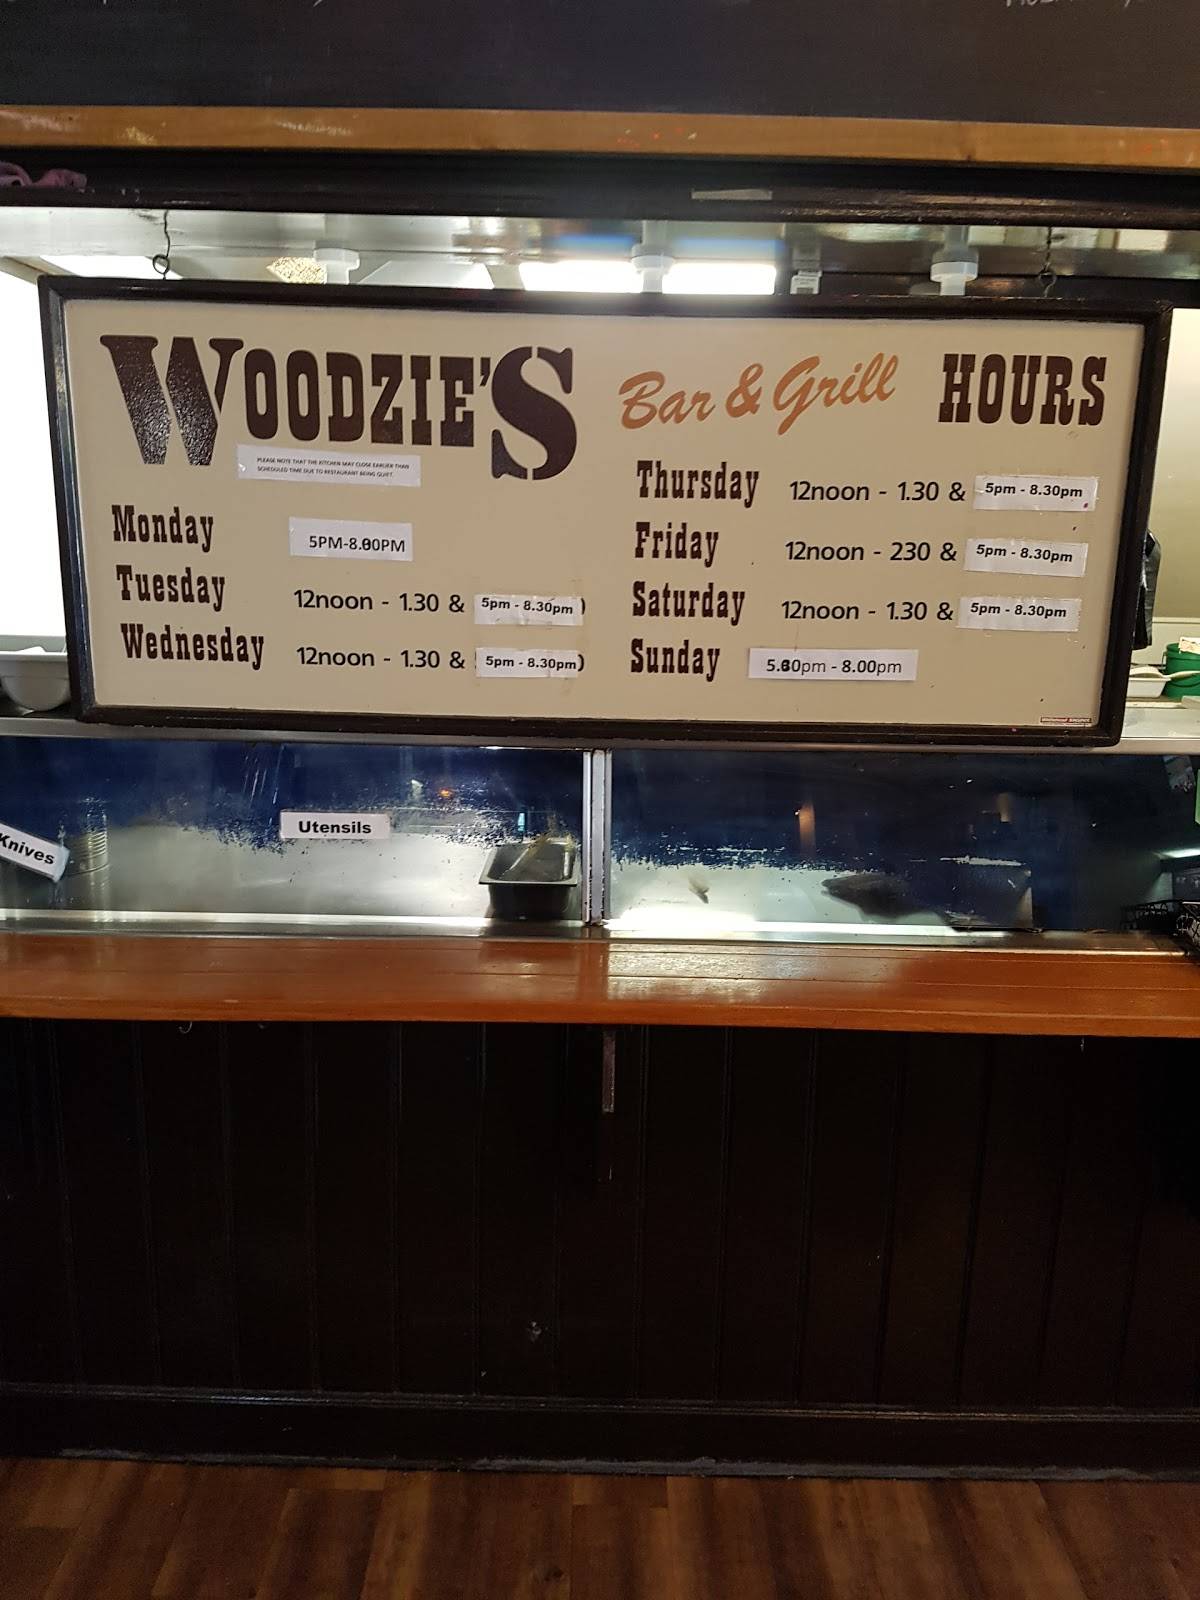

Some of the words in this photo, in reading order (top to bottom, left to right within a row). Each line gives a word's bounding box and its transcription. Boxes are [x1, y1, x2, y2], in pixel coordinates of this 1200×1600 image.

[619, 370, 715, 429] Bar
[725, 363, 765, 418] &
[773, 352, 899, 435] Grill
[938, 353, 1107, 426] HOURS
[100, 334, 577, 481] WOODZIE'S
[637, 460, 759, 509] Thursday
[789, 482, 870, 501] 12noon
[897, 482, 940, 502] 1.30
[948, 483, 967, 502] &
[985, 483, 1017, 497] 5pm
[1029, 485, 1083, 499] 8.30pm
[111, 504, 214, 553] Monday
[634, 521, 720, 568] Friday
[784, 541, 865, 562] 12noon
[889, 542, 931, 562] 230
[940, 543, 957, 562] &
[976, 544, 1006, 558] 5pm
[1019, 546, 1074, 564] 8.30pm
[115, 564, 226, 612] Tuesday
[293, 590, 373, 611] 12noon
[399, 592, 440, 613] 1.30
[448, 595, 466, 613] &
[481, 597, 511, 610] 5pm
[523, 600, 573, 615] 8.30pm
[632, 581, 746, 626] Saturday
[781, 600, 860, 621] 12noon
[886, 602, 927, 622] 1.30
[936, 602, 954, 621] &
[970, 602, 1001, 617] 5pm
[1013, 605, 1068, 620] 8.30pm
[120, 623, 265, 671] Wednesday
[296, 647, 375, 668] 12noon
[400, 650, 441, 669] 1.30
[448, 651, 466, 669] &
[485, 655, 515, 669] 5pm
[631, 638, 721, 682] Sunday
[841, 659, 902, 676] 8.00pm
[298, 821, 372, 834] Utensils
[0, 832, 55, 865] Knives
